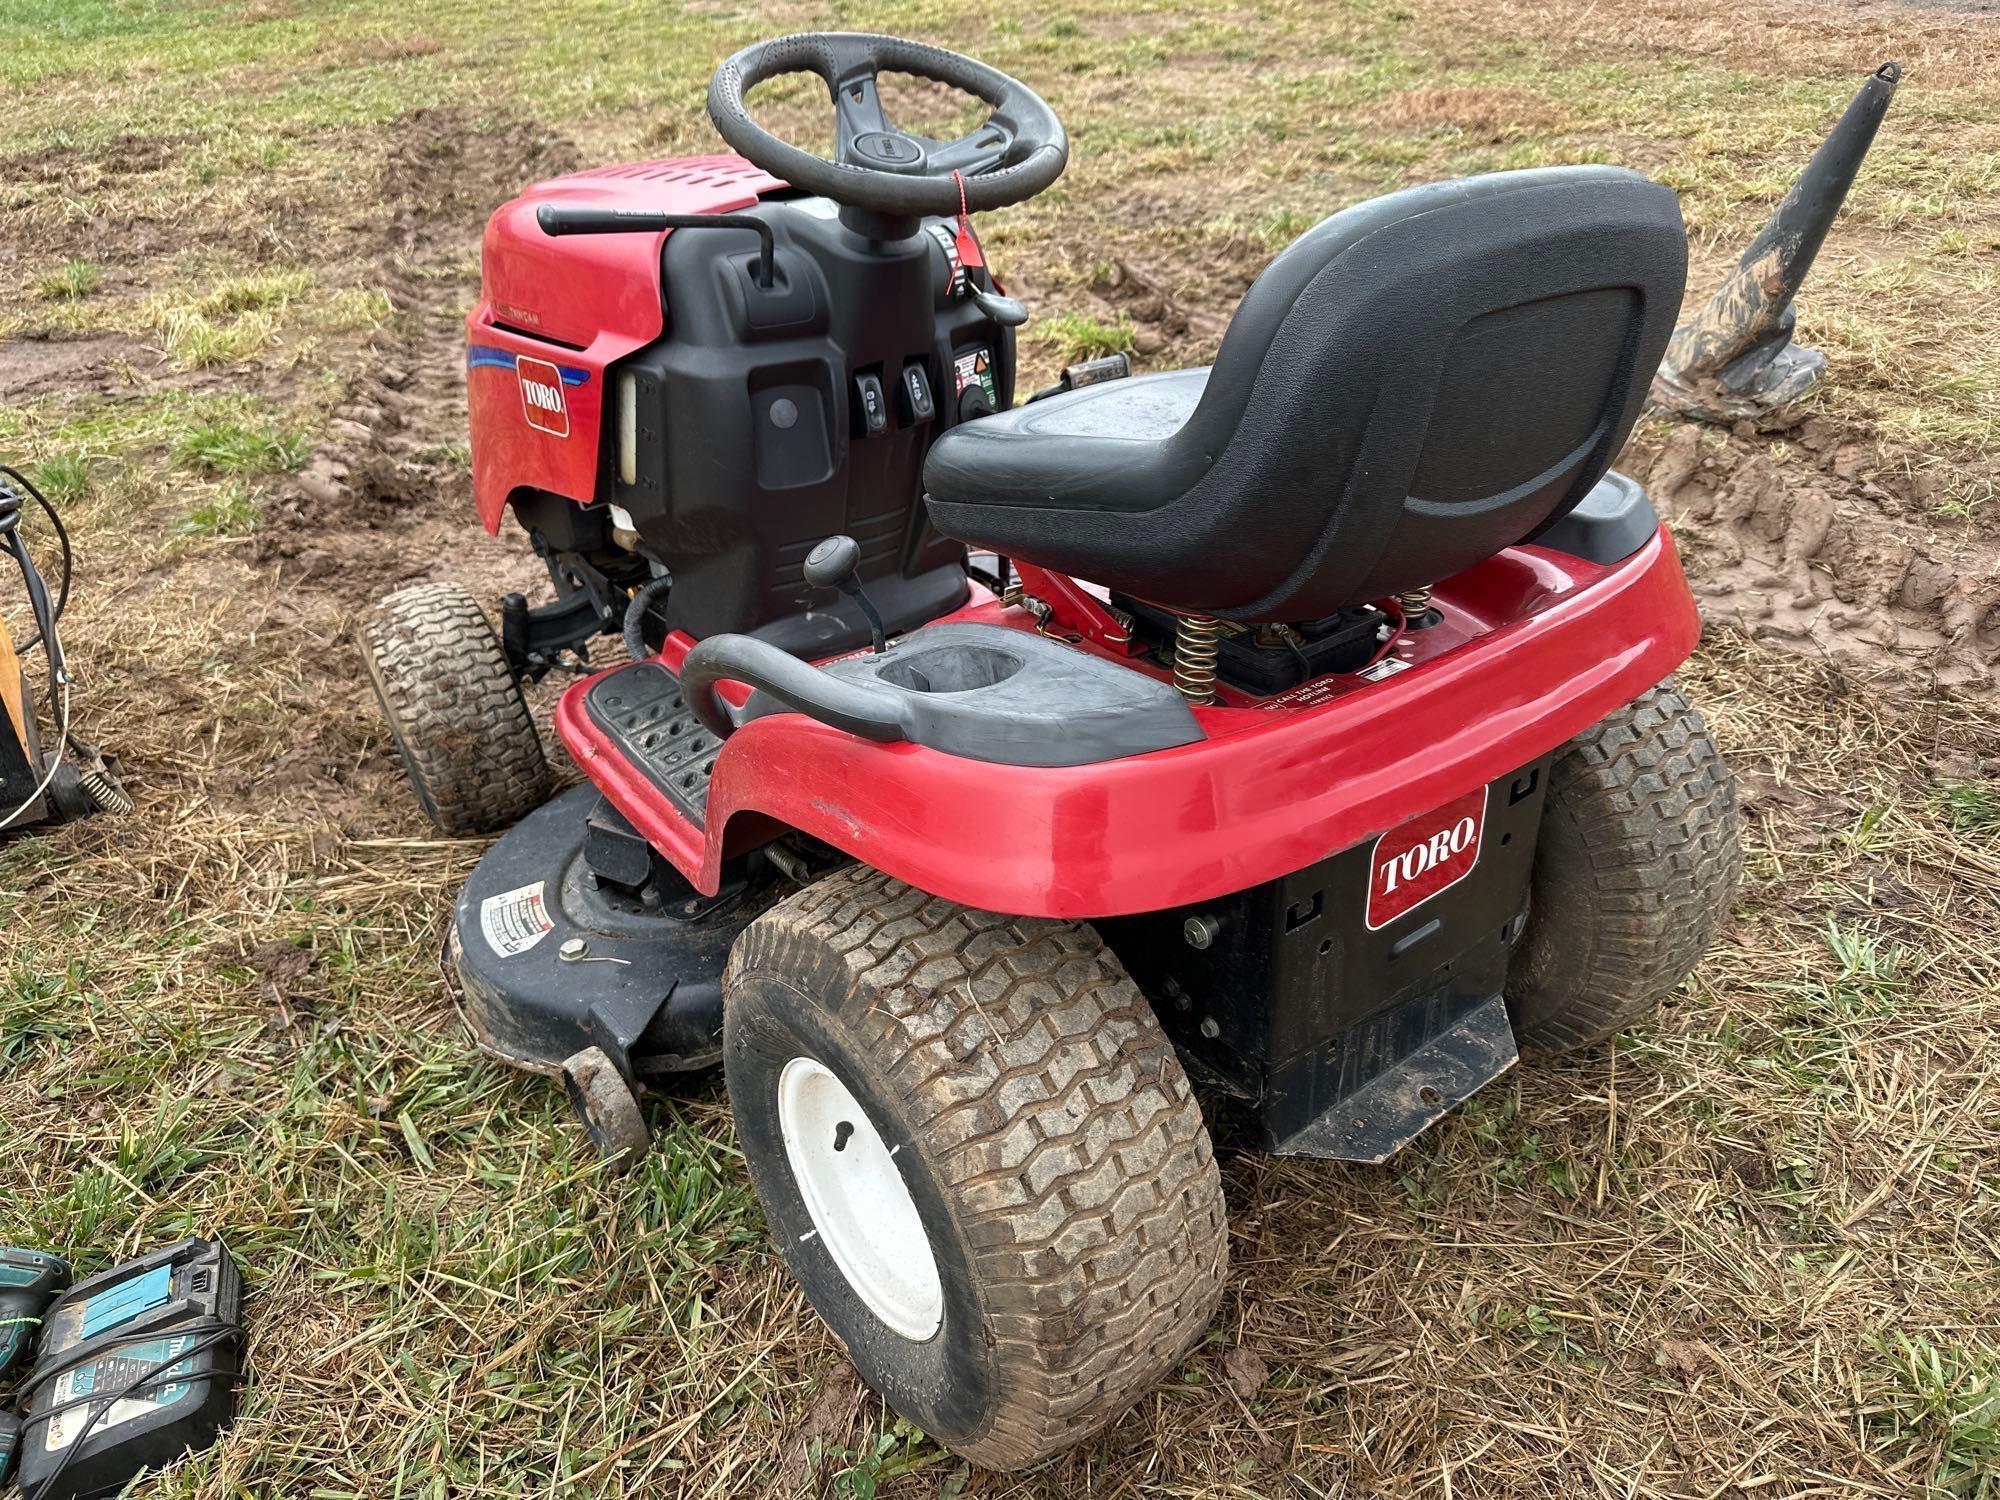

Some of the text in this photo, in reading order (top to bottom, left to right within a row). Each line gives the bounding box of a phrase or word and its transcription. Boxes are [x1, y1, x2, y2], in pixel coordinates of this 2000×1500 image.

[522, 379, 562, 412] TORO
[1276, 677, 1334, 704] CALL THE TORO
[1296, 686, 1331, 702] HOTLINE
[1379, 816, 1475, 896] TORO
